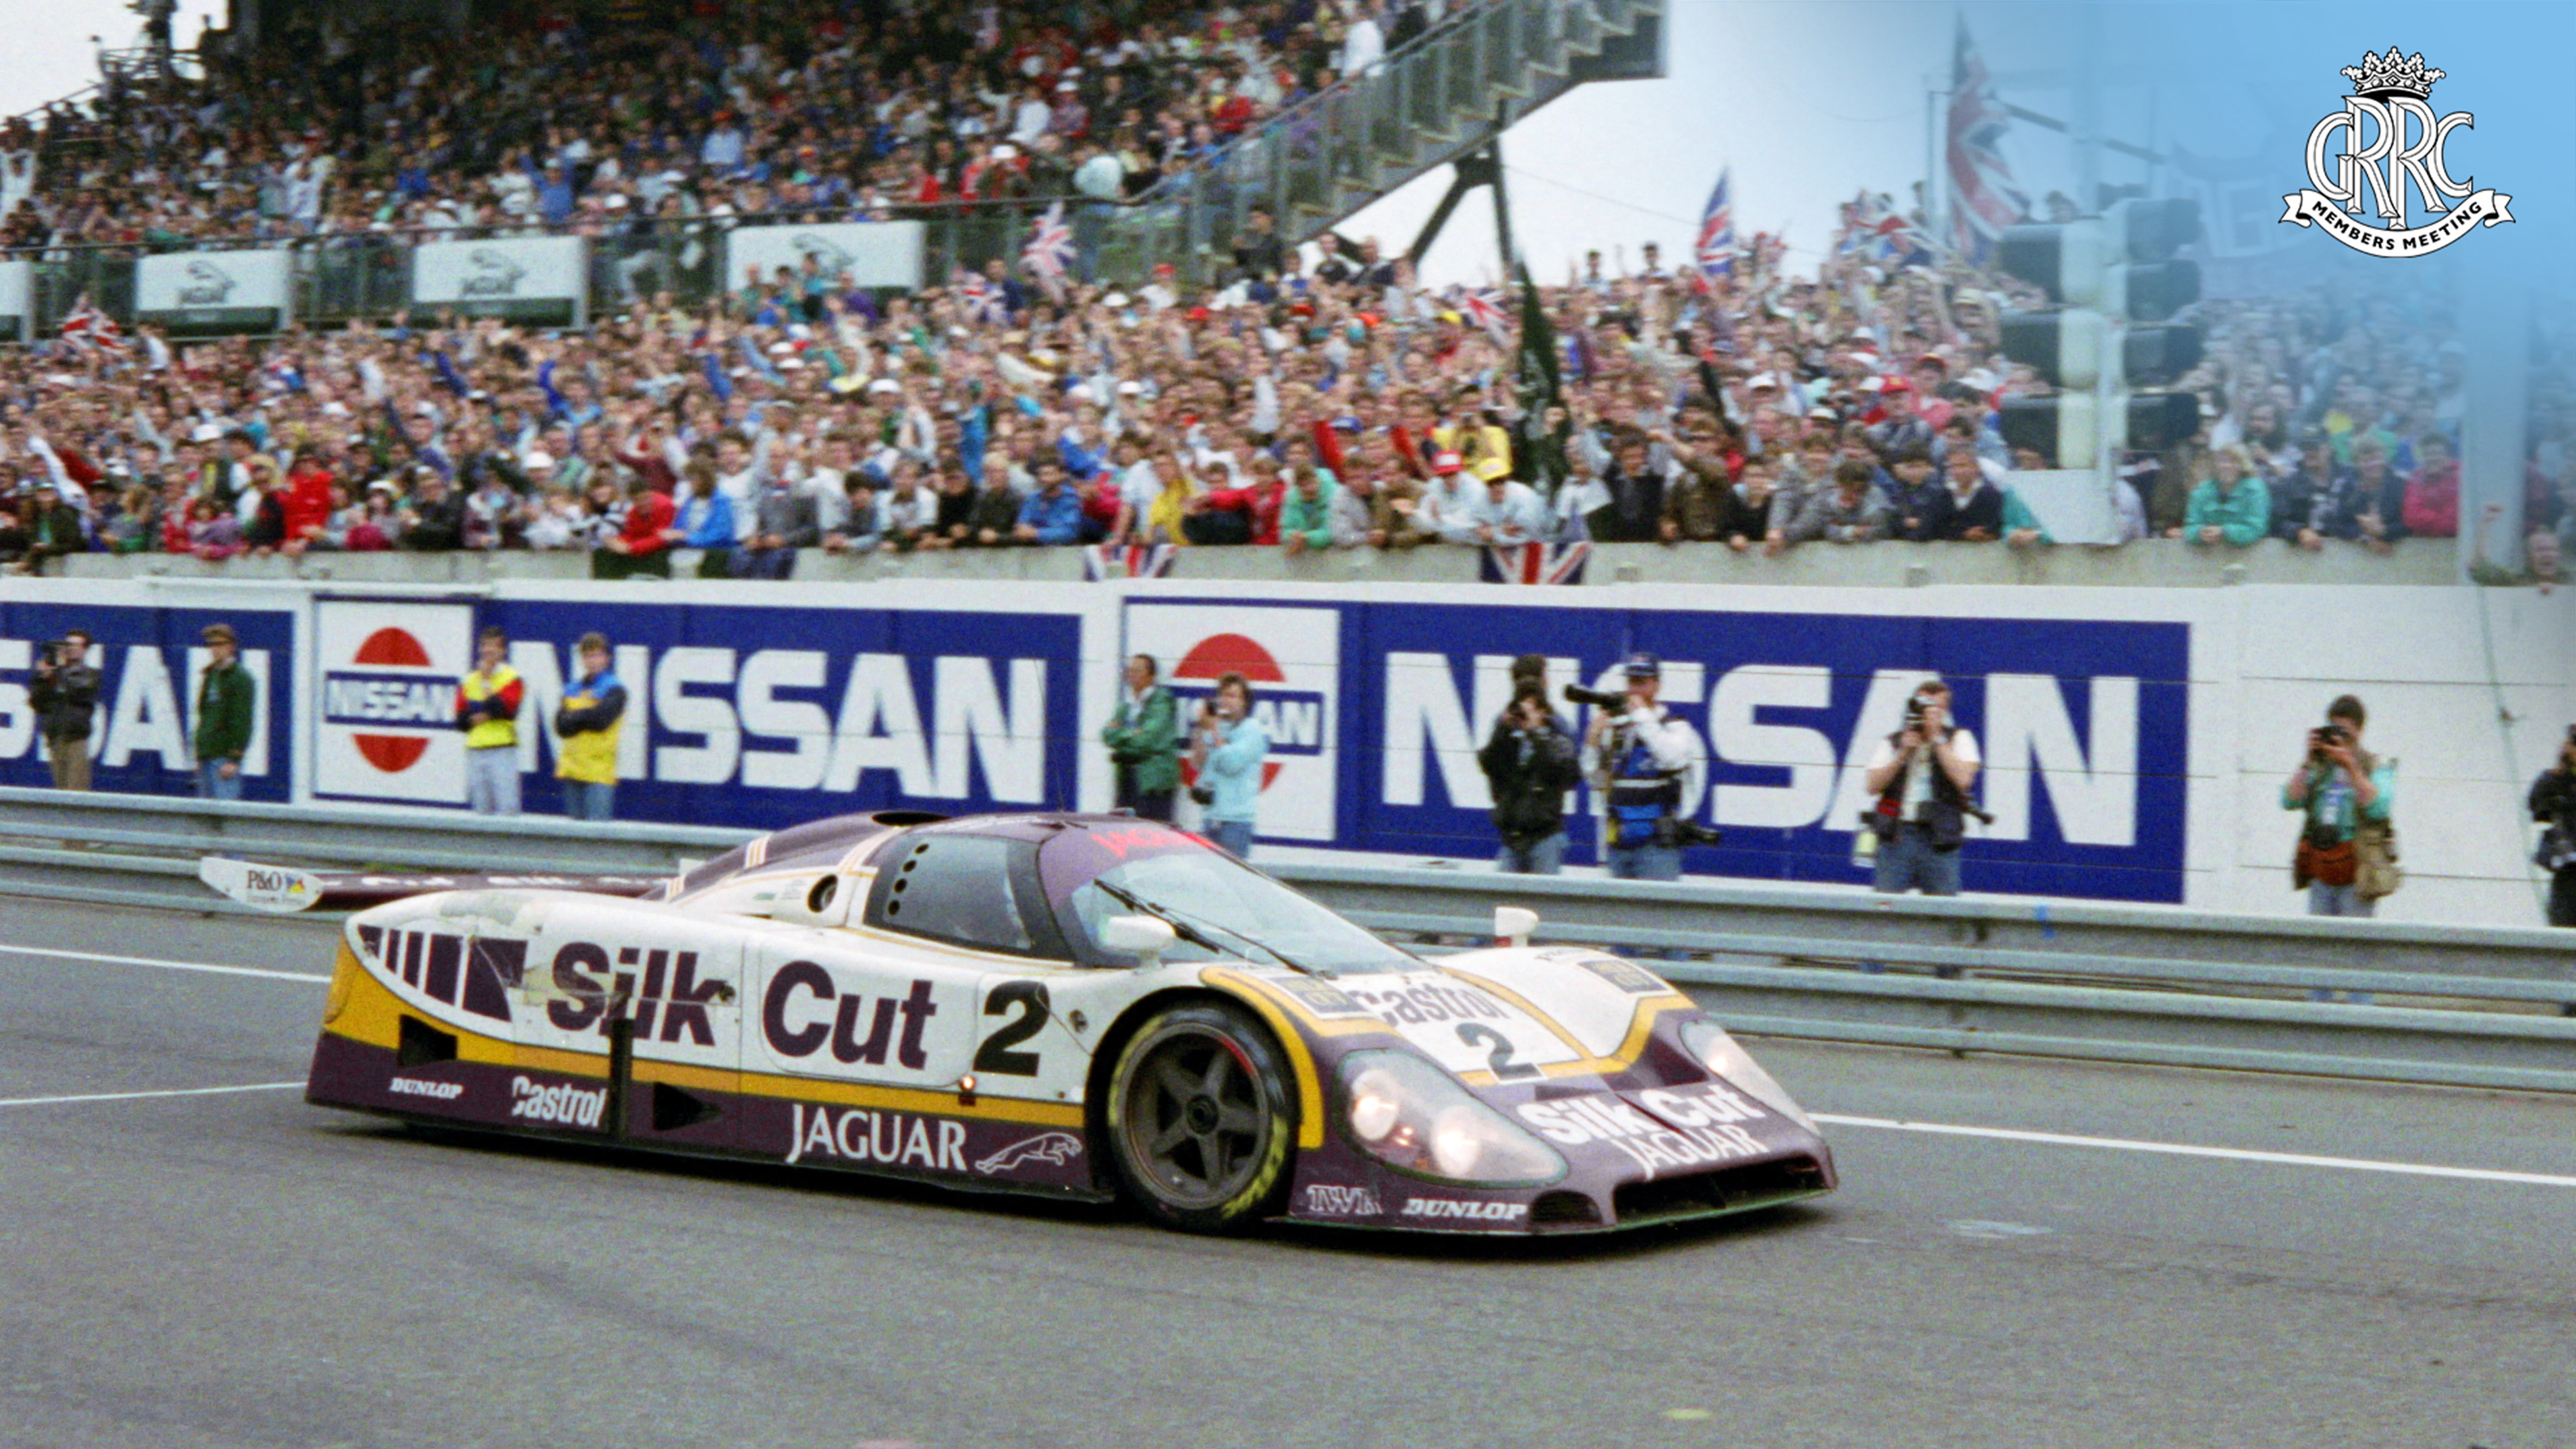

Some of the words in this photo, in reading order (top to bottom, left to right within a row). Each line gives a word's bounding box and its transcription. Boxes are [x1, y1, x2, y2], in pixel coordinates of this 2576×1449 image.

[327, 679, 457, 722] NISSAN
[509, 640, 1046, 803] NISSAN
[246, 870, 282, 891] P&O
[547, 942, 727, 1046] Silk
[762, 960, 937, 1070] Cut
[972, 980, 1051, 1077] 2
[1455, 1023, 1543, 1079] 2
[389, 1077, 464, 1099] DUNLOP
[511, 1076, 607, 1128] Castrol
[1516, 1096, 1664, 1145] Silk
[1640, 1084, 1768, 1127] Cut
[785, 1104, 968, 1171] JAGUAR
[1609, 1125, 1770, 1181] JAGUAR
[1401, 1198, 1530, 1220] DUNLOP
